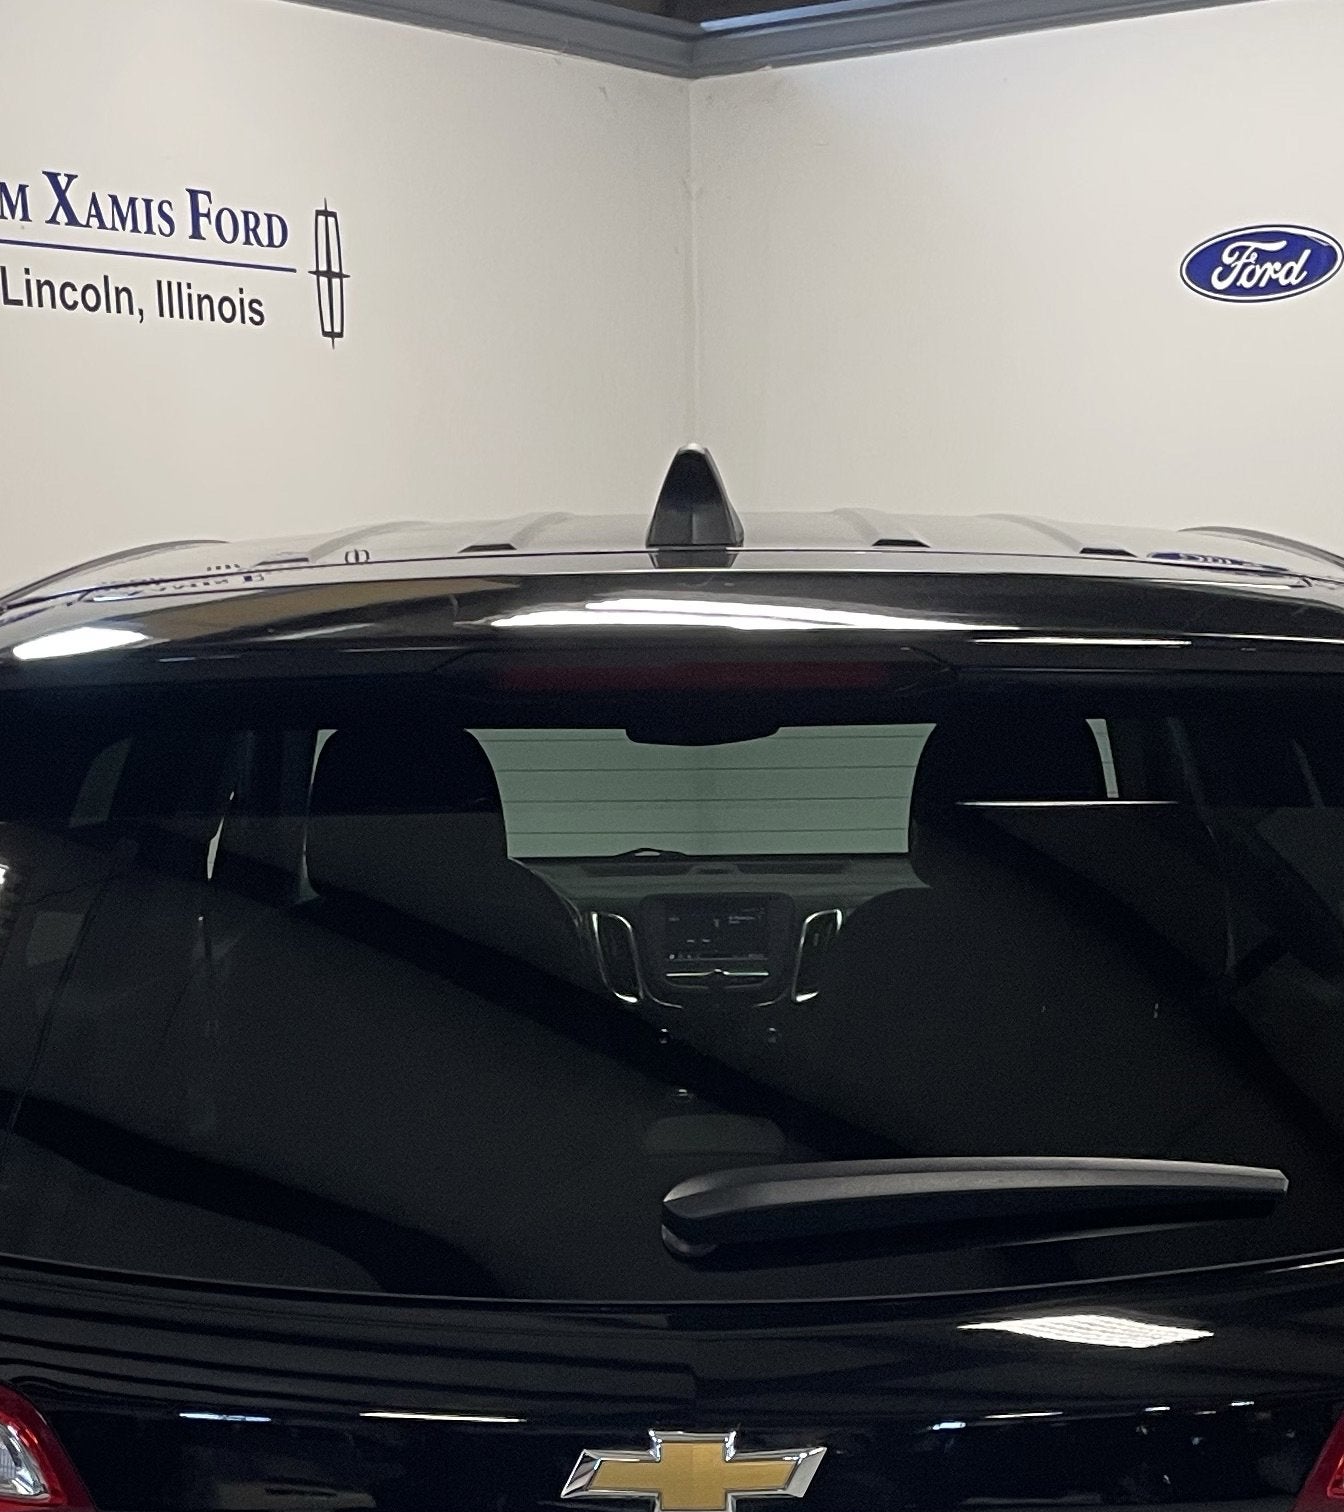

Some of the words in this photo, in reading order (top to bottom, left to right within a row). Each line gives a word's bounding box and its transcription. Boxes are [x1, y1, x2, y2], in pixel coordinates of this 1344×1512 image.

[41, 170, 175, 239] XAMIS
[185, 187, 289, 249] FORD
[1211, 239, 1308, 290] Ford
[0, 265, 145, 323] Lincoln,
[156, 279, 265, 327] Illinois
